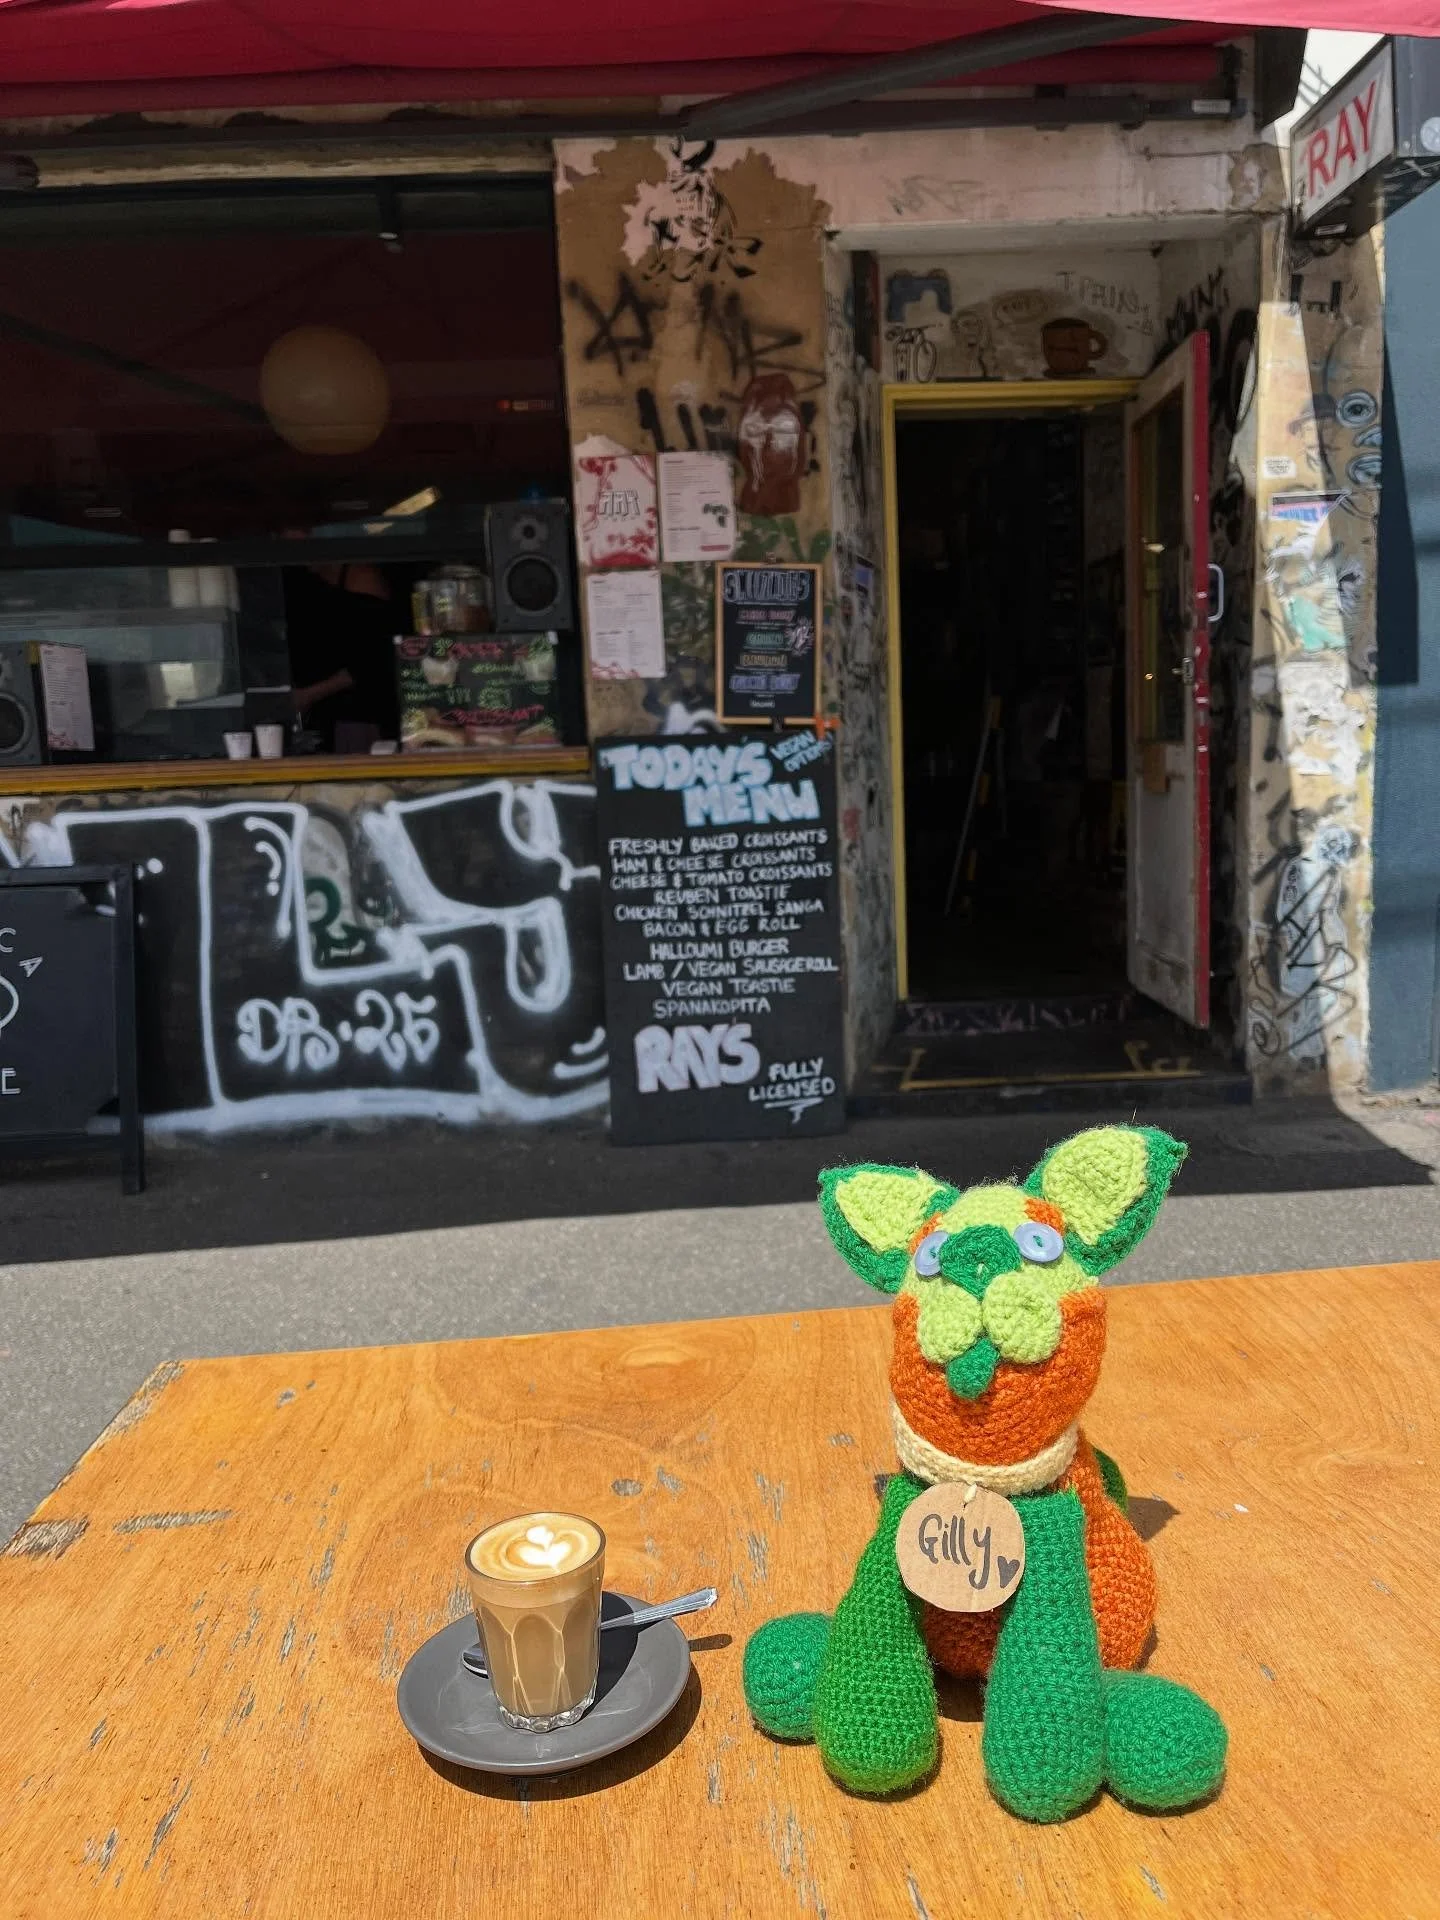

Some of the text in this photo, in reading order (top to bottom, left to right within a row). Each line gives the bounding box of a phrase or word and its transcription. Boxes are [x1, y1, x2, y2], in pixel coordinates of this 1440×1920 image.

[1304, 80, 1376, 197] RAY
[683, 779, 820, 828] MENU
[608, 828, 828, 856] FRESHLY BAKED CROISSANTS
[611, 847, 817, 874] HAM & CHEESE CROISSANTS
[610, 862, 833, 890] CHEESE & TOMATO CROISSANTS
[653, 888, 719, 905] REUBEN
[614, 899, 825, 921] CHICKEN SCHNITZEL SANGA
[642, 921, 696, 938] BACON
[714, 919, 750, 936] EGG
[758, 916, 800, 932] ROLL
[650, 937, 790, 961] HALLOUMI BURGER
[623, 962, 666, 981] LAMB
[686, 962, 737, 978] VEGAN
[661, 978, 796, 998] VEGAN TOASTIE
[653, 997, 771, 1019] SPANAKOPITA
[768, 1057, 824, 1081] FULLY
[749, 1078, 836, 1102] LICENSED
[918, 1513, 992, 1590] Gilly
